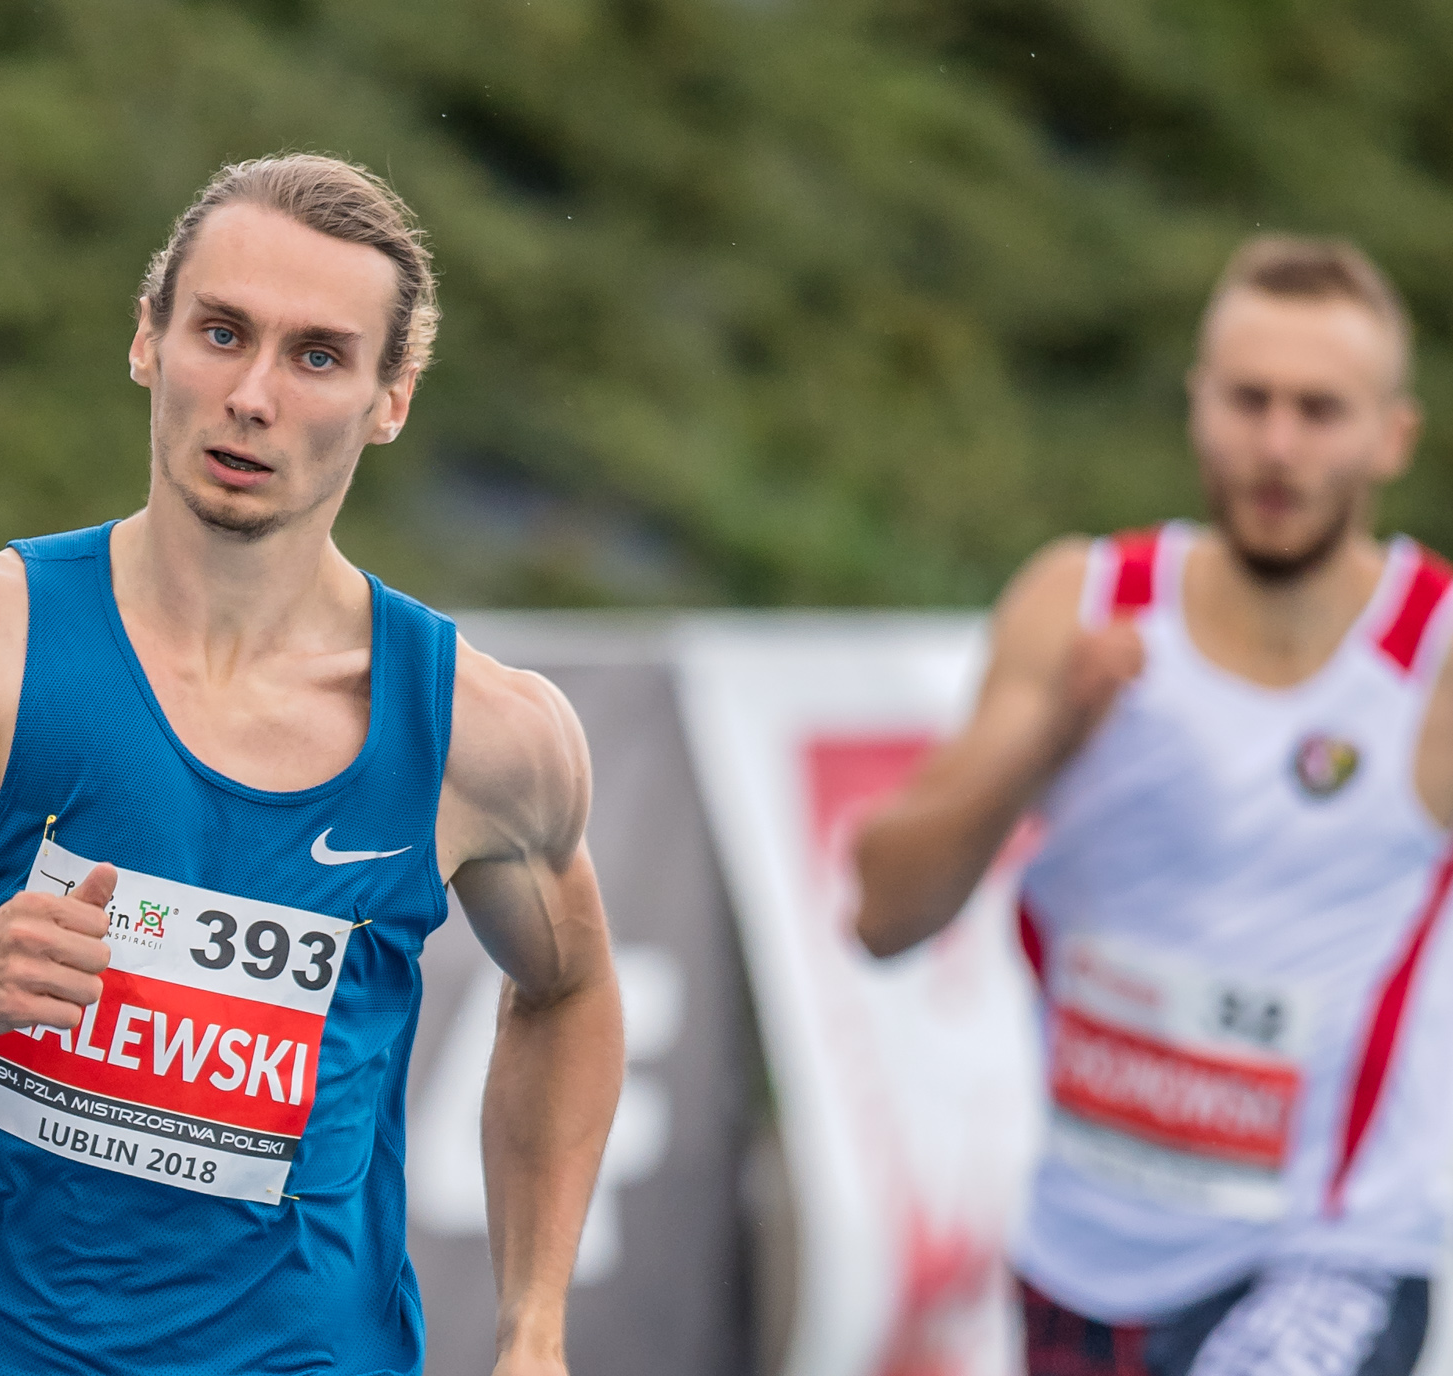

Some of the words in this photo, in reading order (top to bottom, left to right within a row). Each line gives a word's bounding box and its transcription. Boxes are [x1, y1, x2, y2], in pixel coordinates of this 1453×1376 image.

[106, 930, 163, 950] NSPIRACJI
[189, 909, 338, 991] 393
[14, 1000, 308, 1106] LEWSKI
[23, 1078, 67, 1107] PZLA
[70, 1096, 216, 1143] MISTRZOSTWA
[220, 1131, 286, 1155] POLSKI
[38, 1117, 139, 1166] LUBLIN
[146, 1148, 217, 1184] 2018
